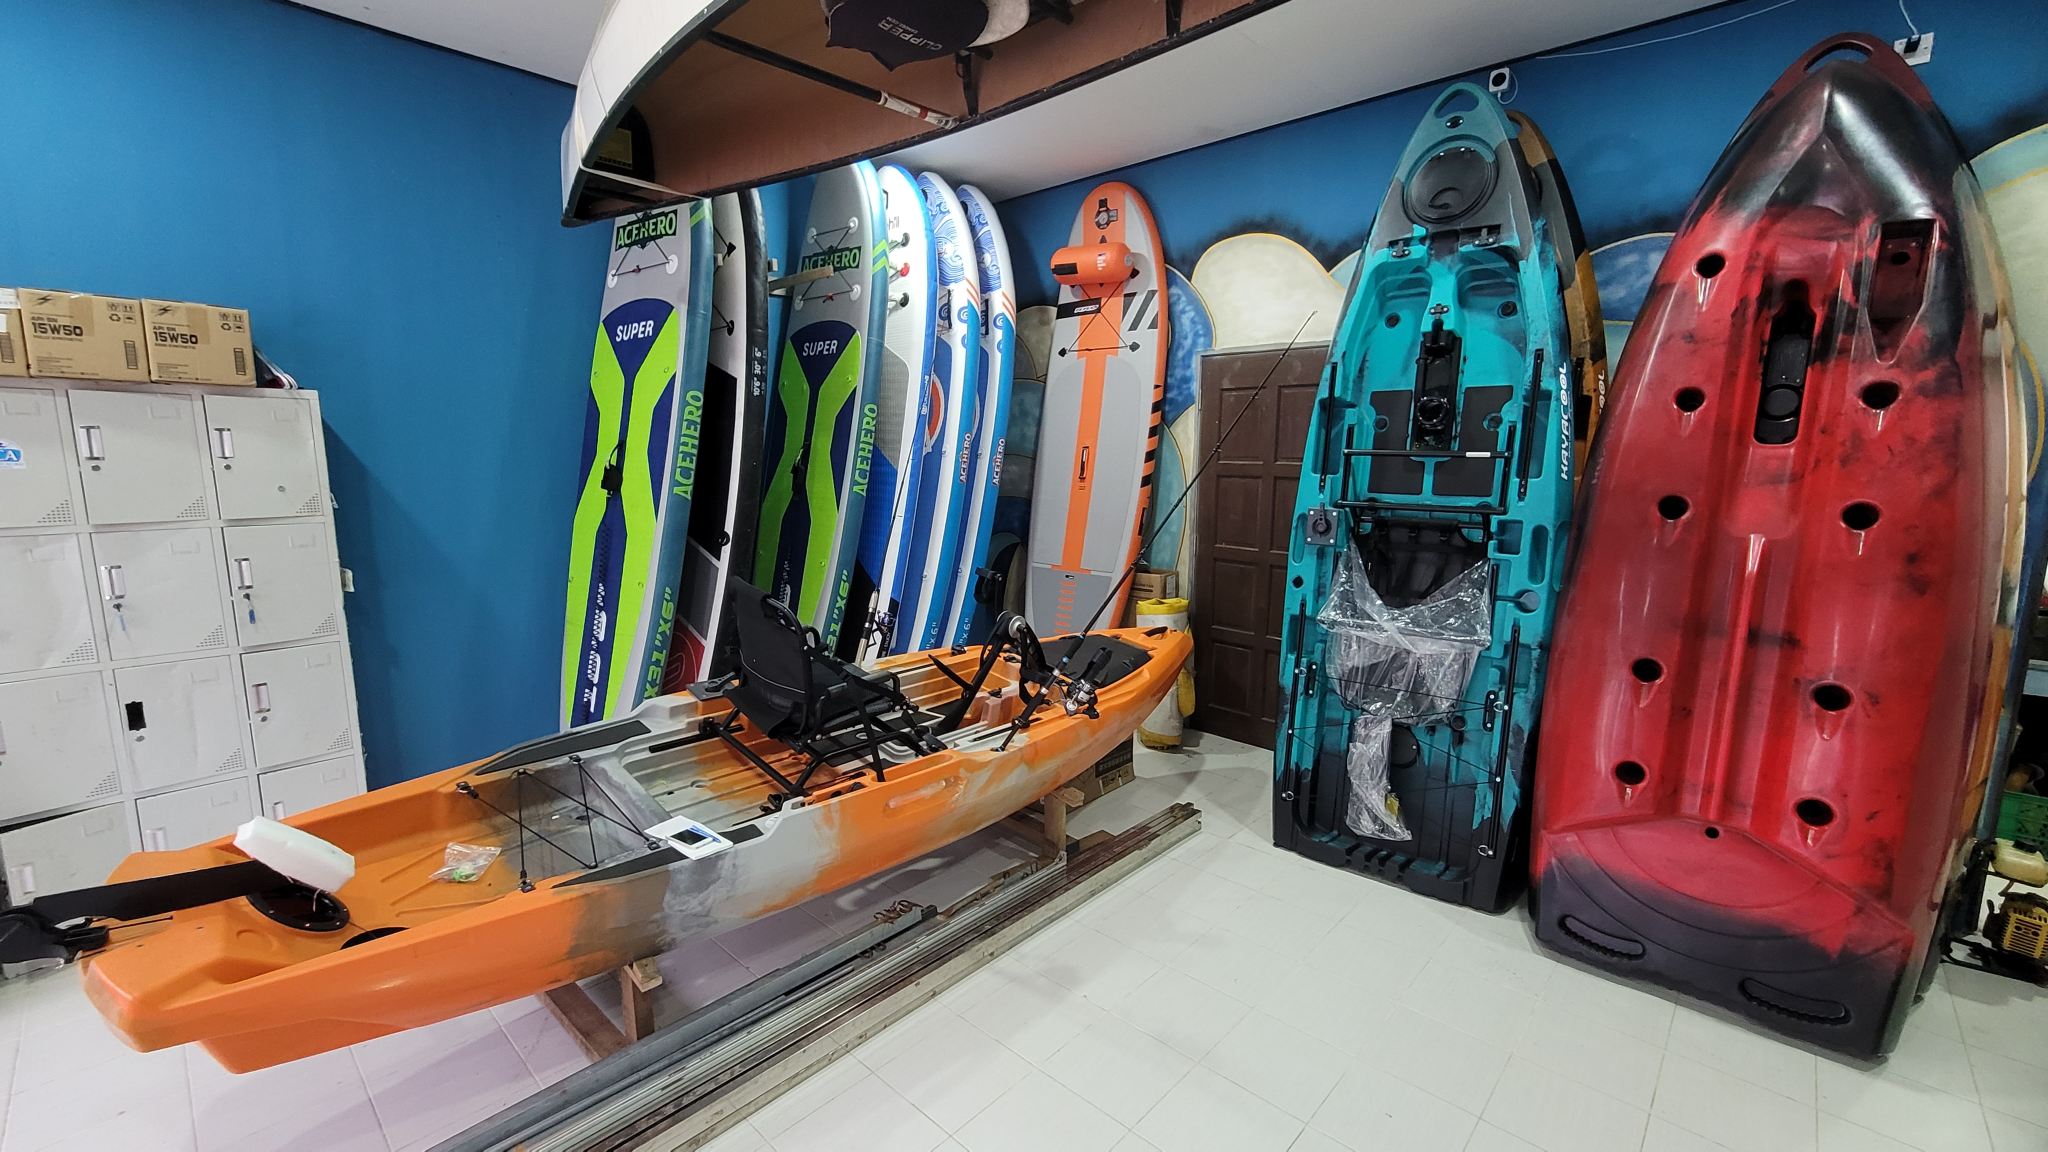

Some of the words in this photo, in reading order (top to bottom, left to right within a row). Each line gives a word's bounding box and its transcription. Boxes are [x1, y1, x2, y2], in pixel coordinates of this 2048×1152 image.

[877, 17, 943, 51] CLIPPER
[616, 212, 677, 249] ACEHERO
[31, 322, 84, 337] 15W50
[153, 331, 199, 345] 15W50
[615, 319, 655, 343] SUPER
[801, 338, 839, 358] SUPER
[1559, 361, 1568, 481] KAYACOOL
[672, 389, 705, 502] ACEHERO
[852, 402, 878, 498] ACEHERO
[959, 432, 973, 484] ACEHERO
[992, 437, 1006, 487] ACEHERO
